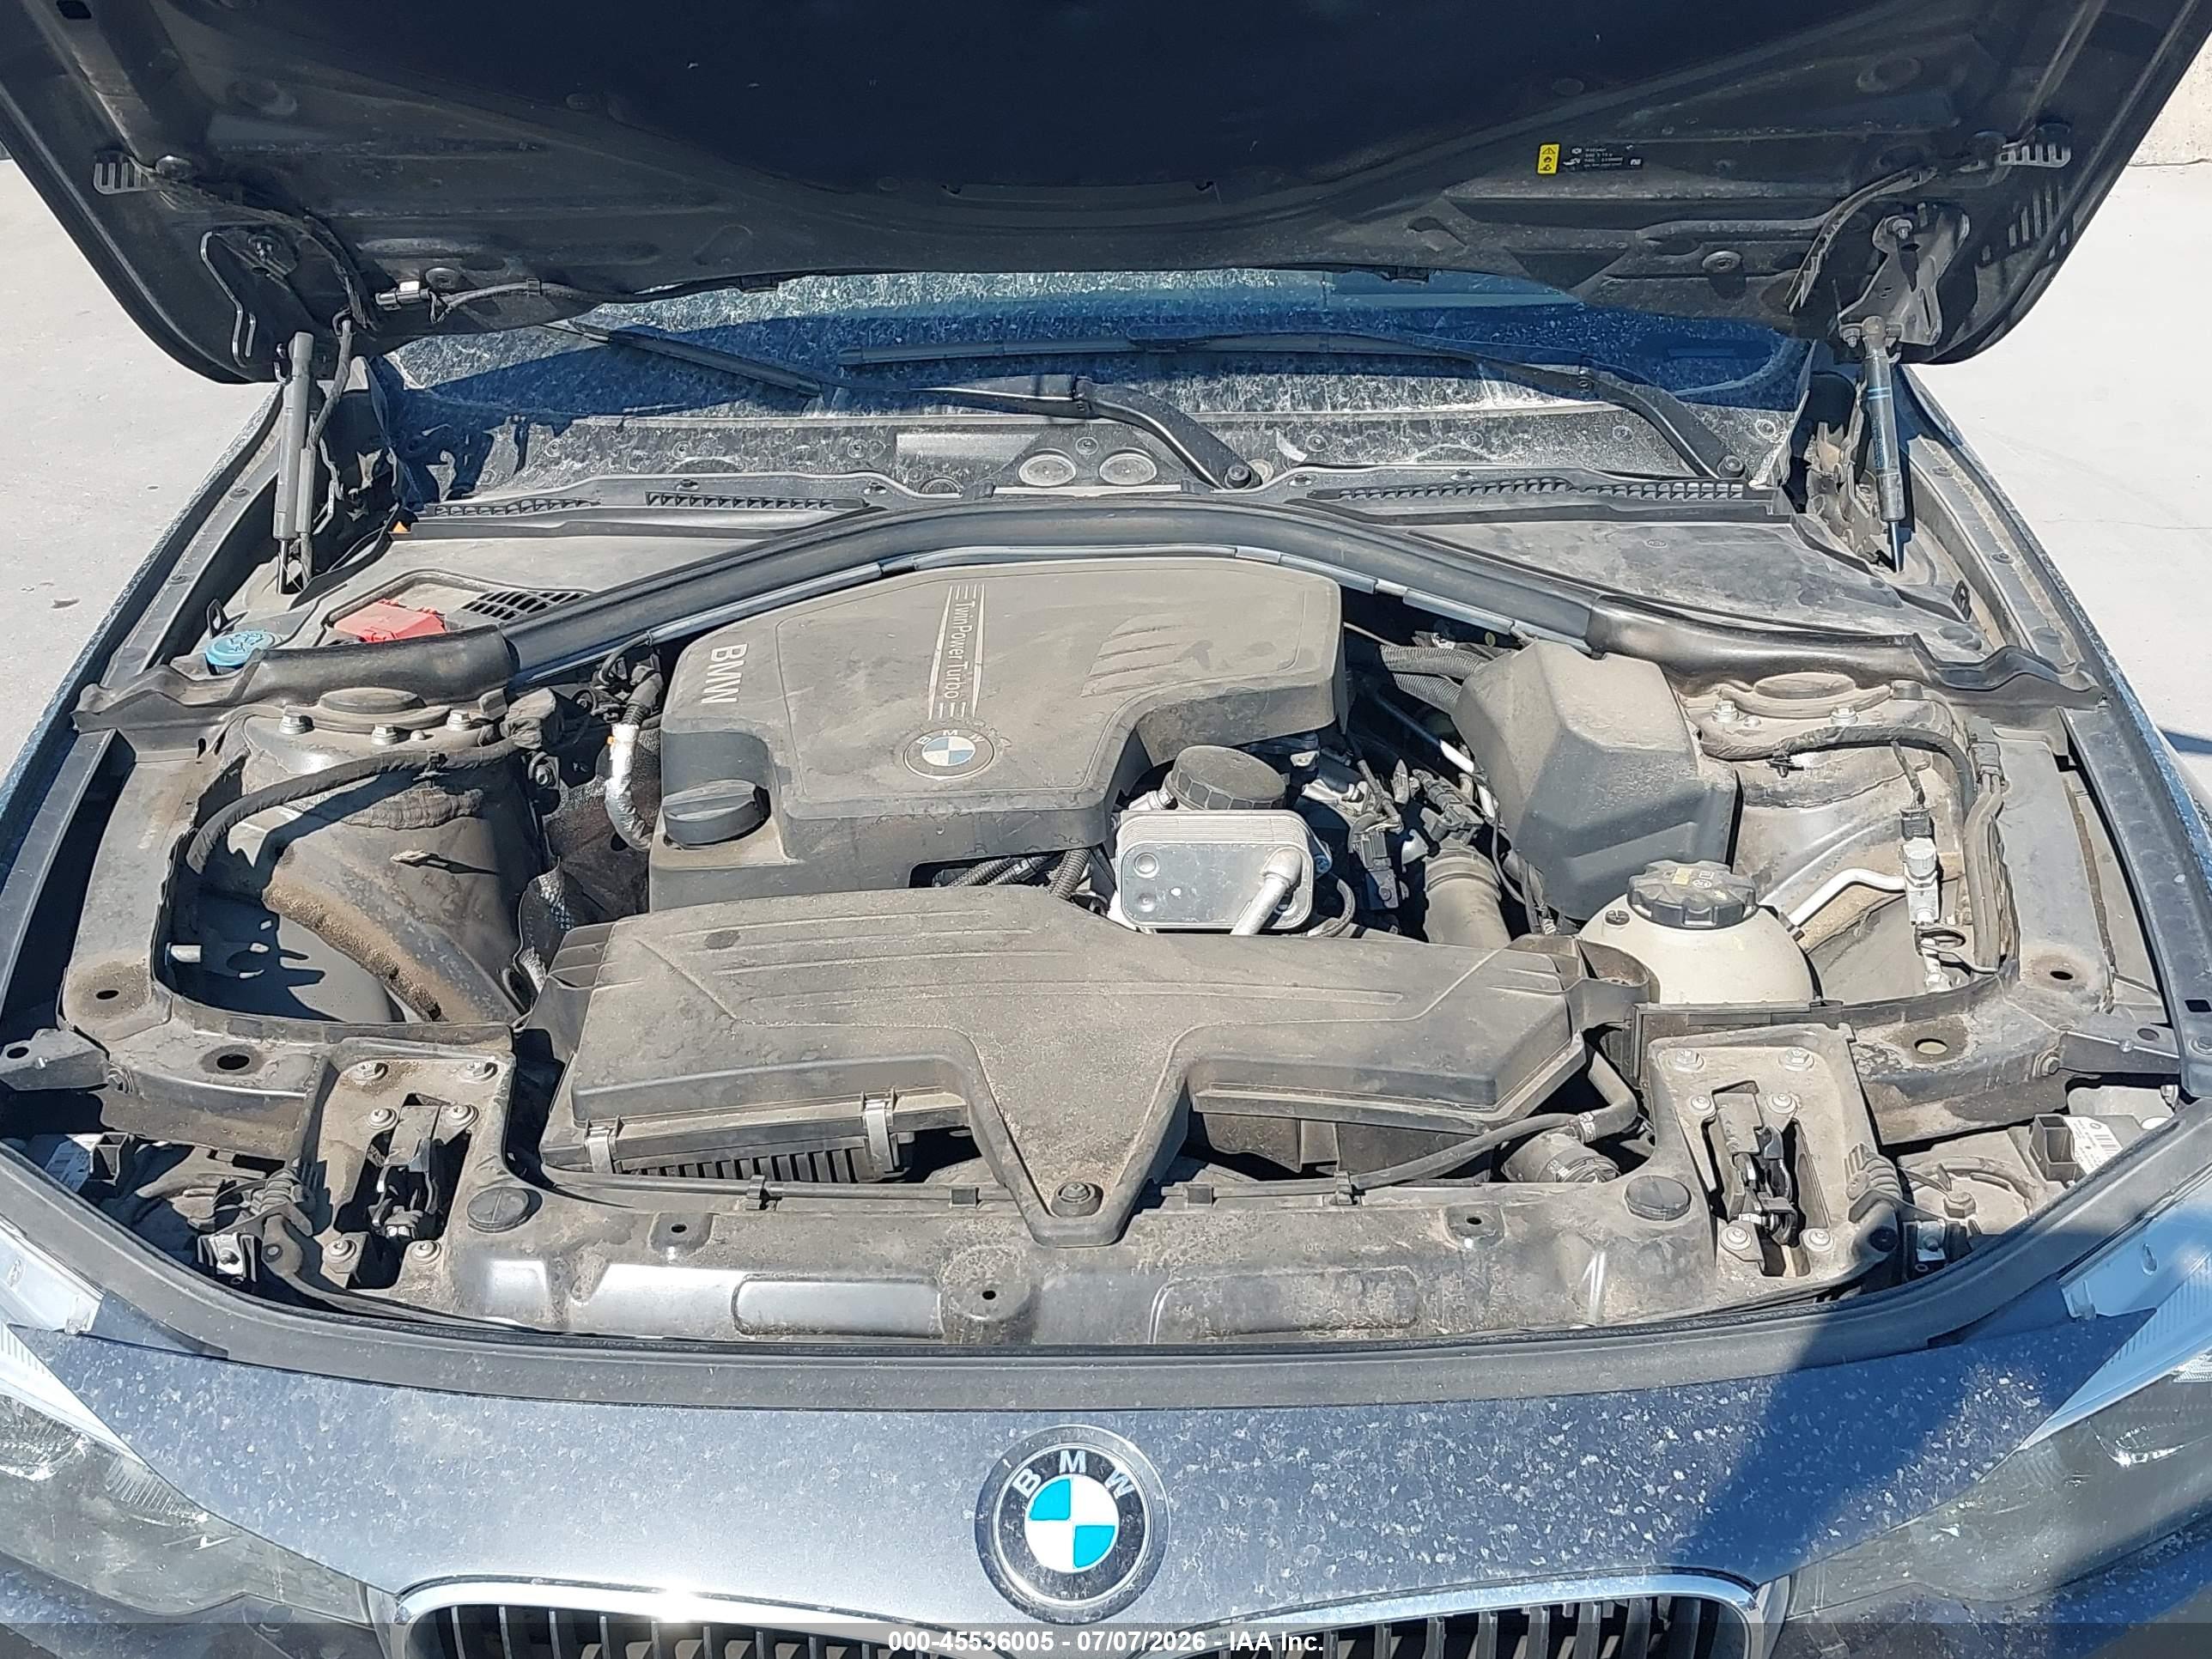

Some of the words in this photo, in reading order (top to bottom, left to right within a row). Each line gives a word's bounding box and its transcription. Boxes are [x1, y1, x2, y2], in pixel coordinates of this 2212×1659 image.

[948, 600, 975, 659] TwinPower
[701, 643, 748, 704] BMW
[945, 660, 969, 699] Turbo
[916, 729, 985, 745] BMW
[1012, 1449, 1135, 1499] BMW
